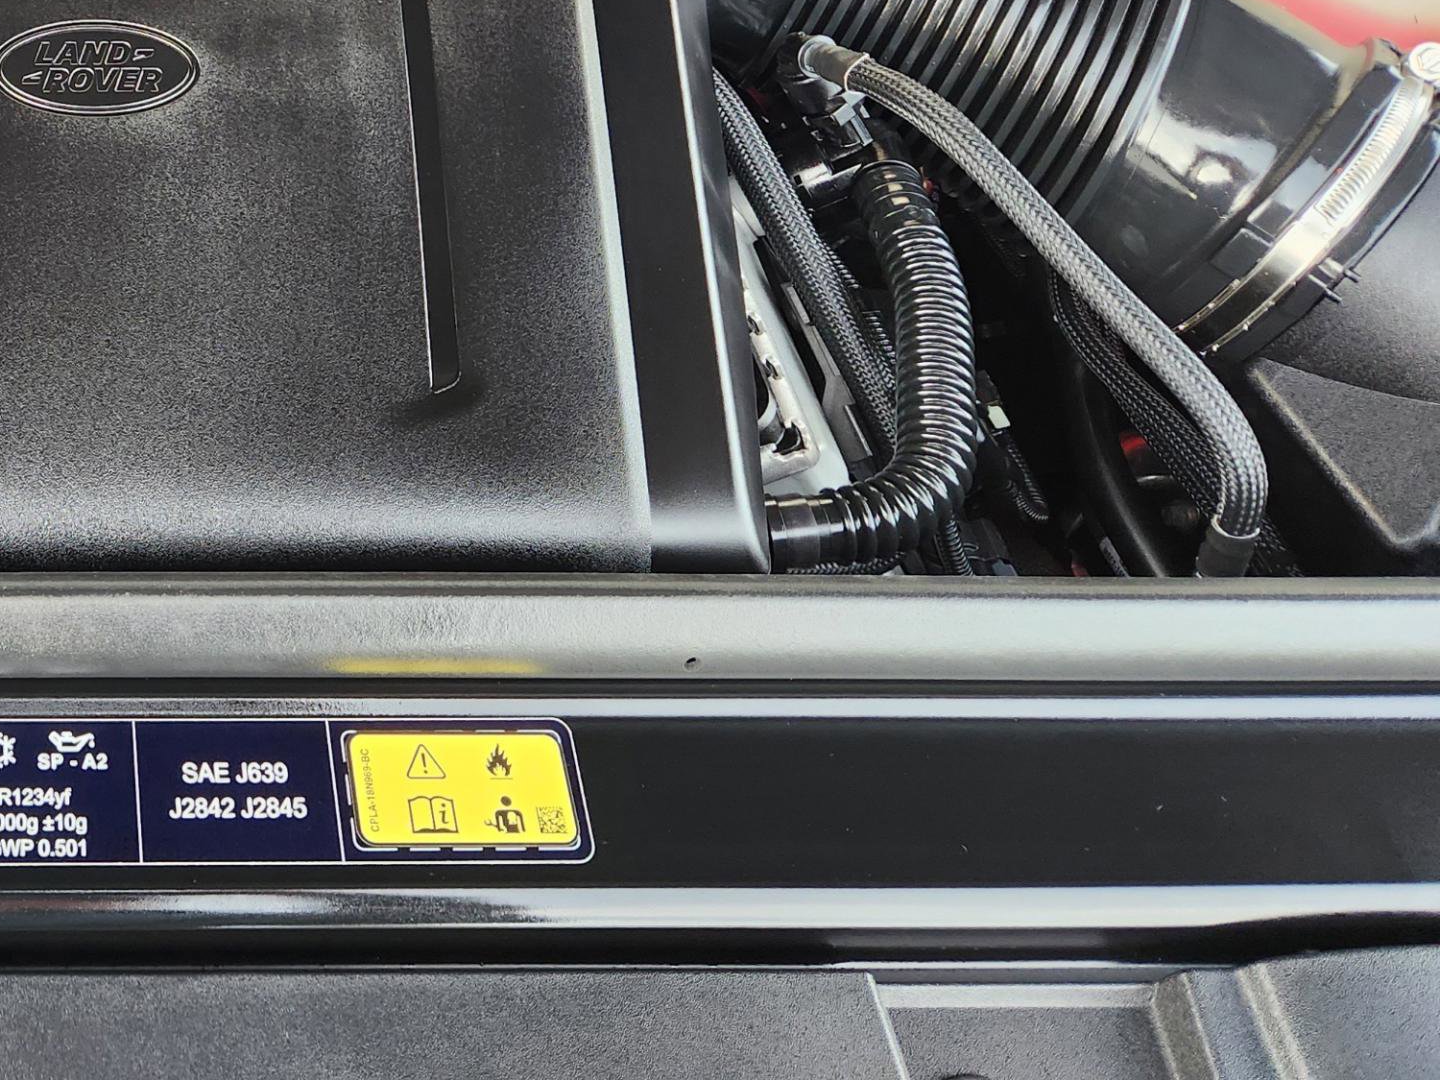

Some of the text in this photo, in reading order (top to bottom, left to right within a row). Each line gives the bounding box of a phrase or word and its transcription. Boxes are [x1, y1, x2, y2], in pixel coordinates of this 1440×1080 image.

[34, 40, 132, 67] LAND
[42, 66, 163, 94] ROVER
[37, 752, 109, 770] SP - A2
[181, 761, 289, 784] SAE J639
[168, 796, 308, 819] J2842 J2845
[42, 812, 88, 835] ±10g
[37, 838, 87, 858] 0.501
